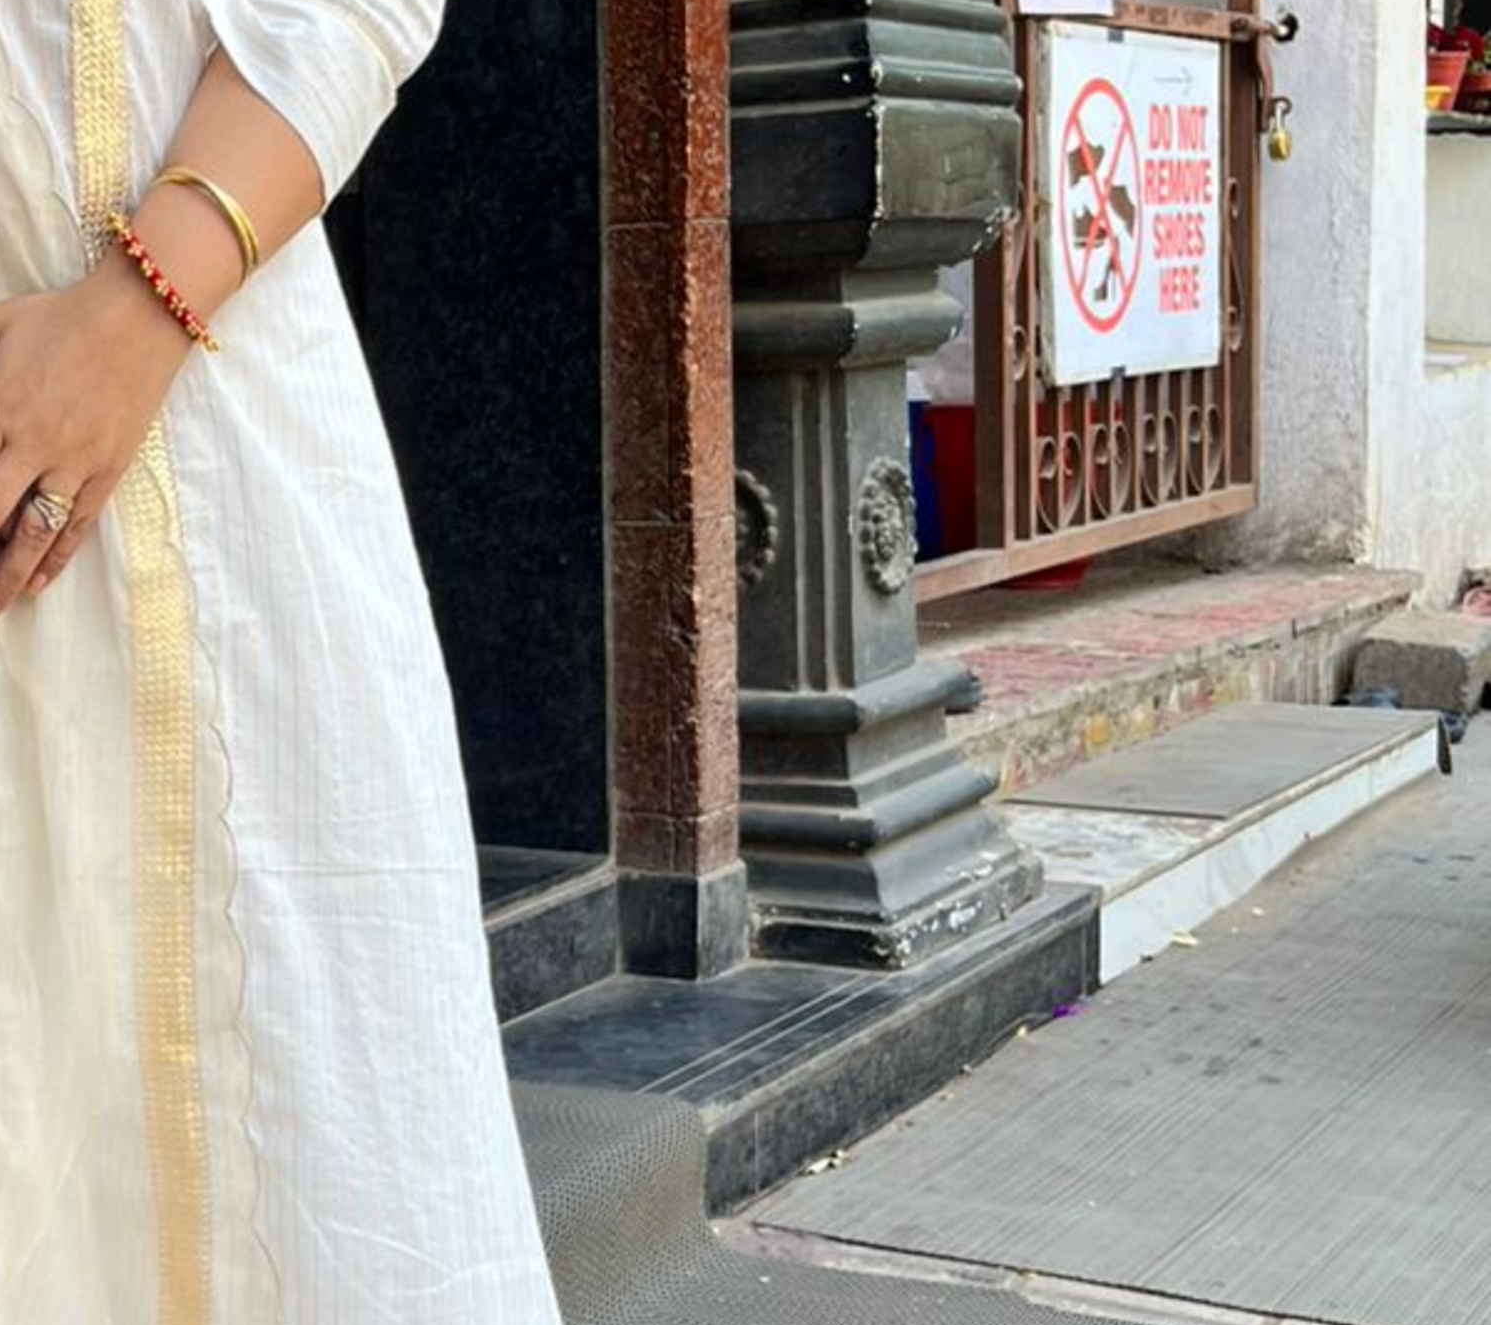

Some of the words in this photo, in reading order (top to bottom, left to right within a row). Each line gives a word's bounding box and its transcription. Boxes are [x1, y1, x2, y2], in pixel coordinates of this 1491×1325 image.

[1149, 105, 1172, 150] DO
[1177, 105, 1206, 150] NOT
[1143, 159, 1212, 205] REMOVE
[1153, 212, 1204, 259] SHOES
[1159, 266, 1200, 313] HERE
